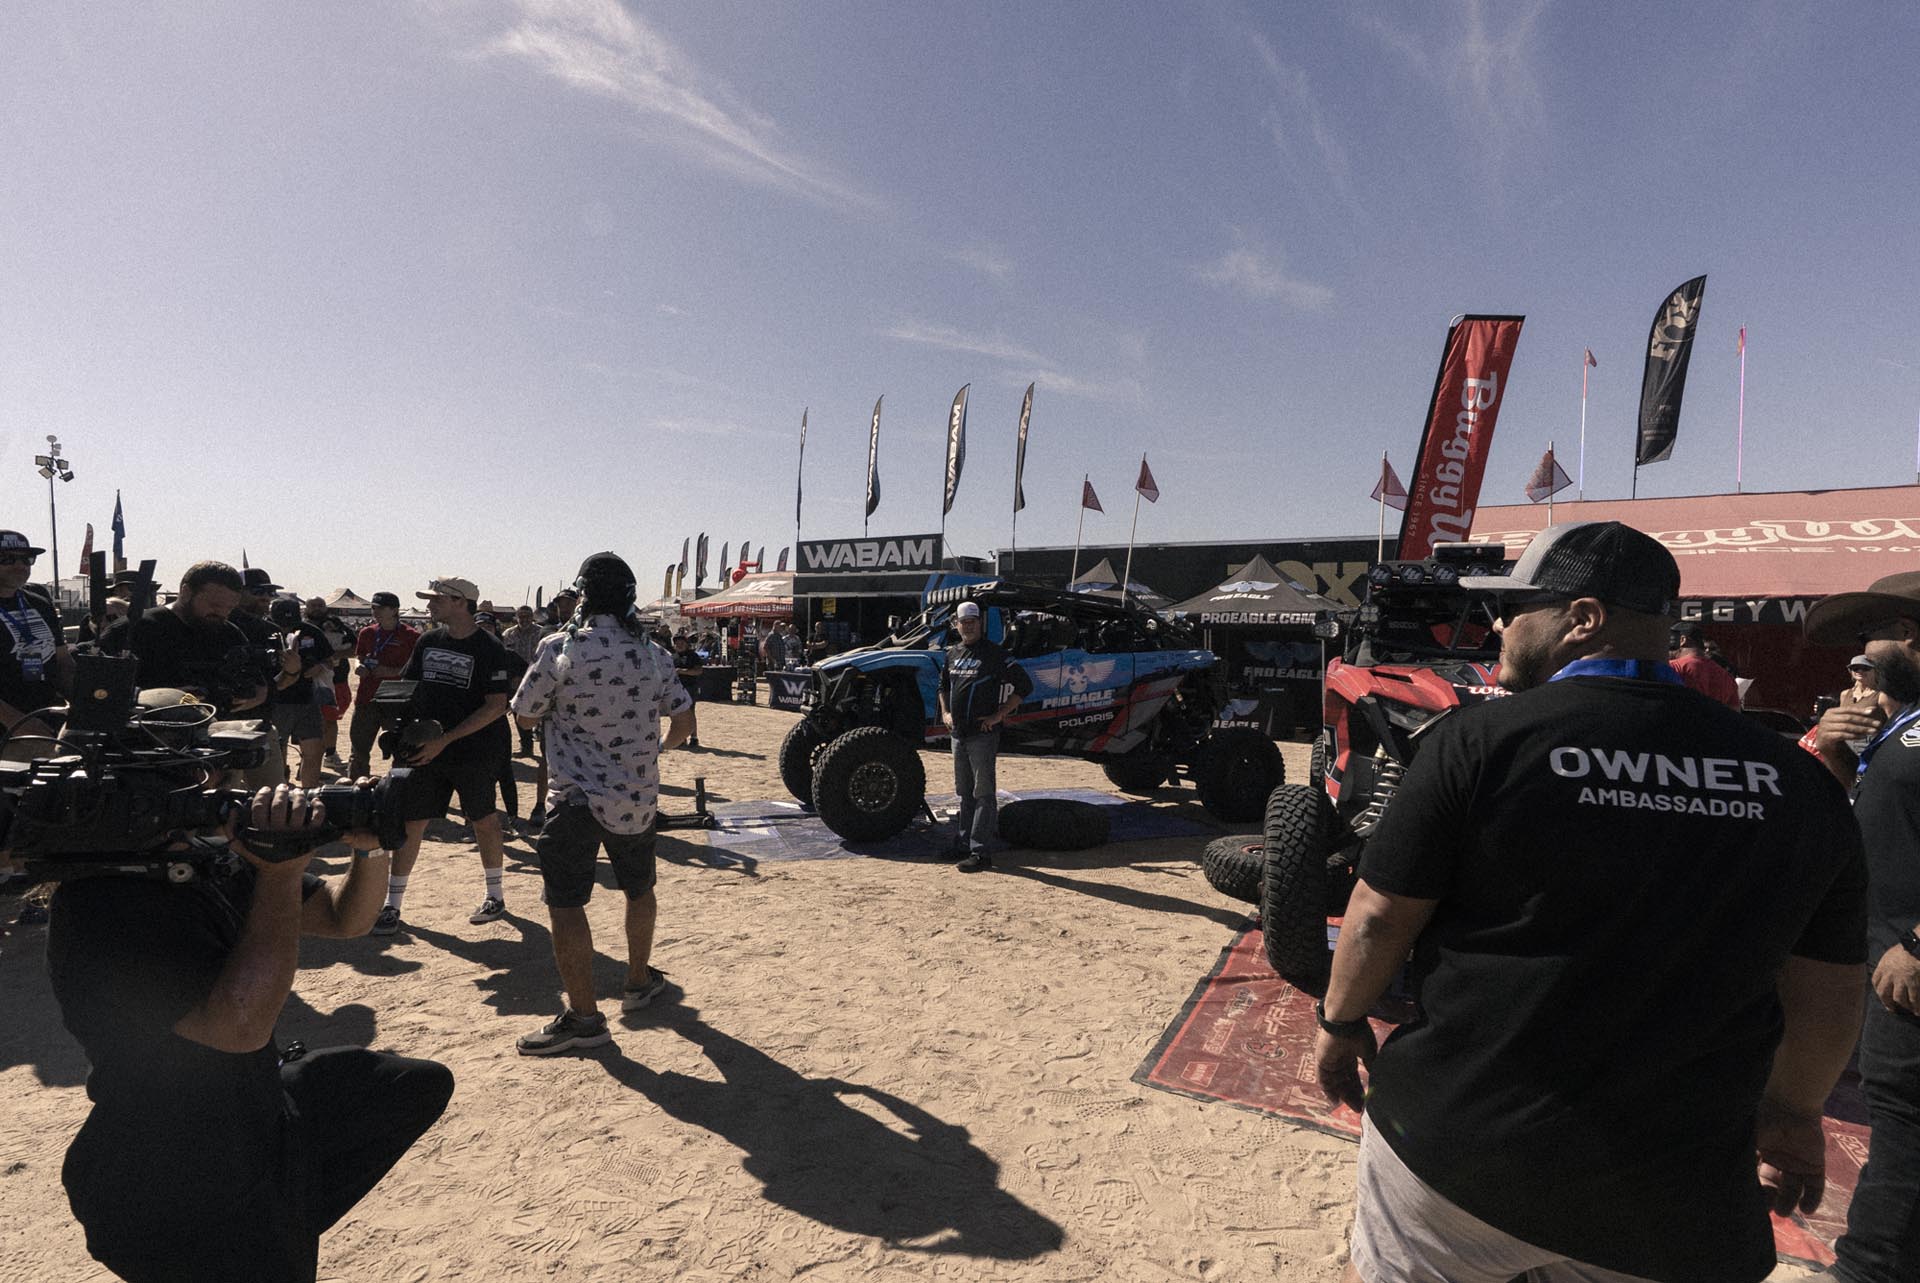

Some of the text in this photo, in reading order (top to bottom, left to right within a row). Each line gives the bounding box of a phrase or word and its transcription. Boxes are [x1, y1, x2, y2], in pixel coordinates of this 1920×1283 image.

[1428, 371, 1498, 508] Buggy
[1413, 472, 1430, 508] SINCE
[803, 538, 935, 569] WABAM
[1232, 592, 1273, 600] EAGLE
[1200, 612, 1316, 625] PROEAGLE.COM
[1042, 695, 1071, 710] PRO
[1071, 689, 1115, 705] EAGLE
[1058, 711, 1115, 729] POLARIS
[1549, 746, 1783, 796] OWNER
[1577, 786, 1765, 820] AMBASSADOR
